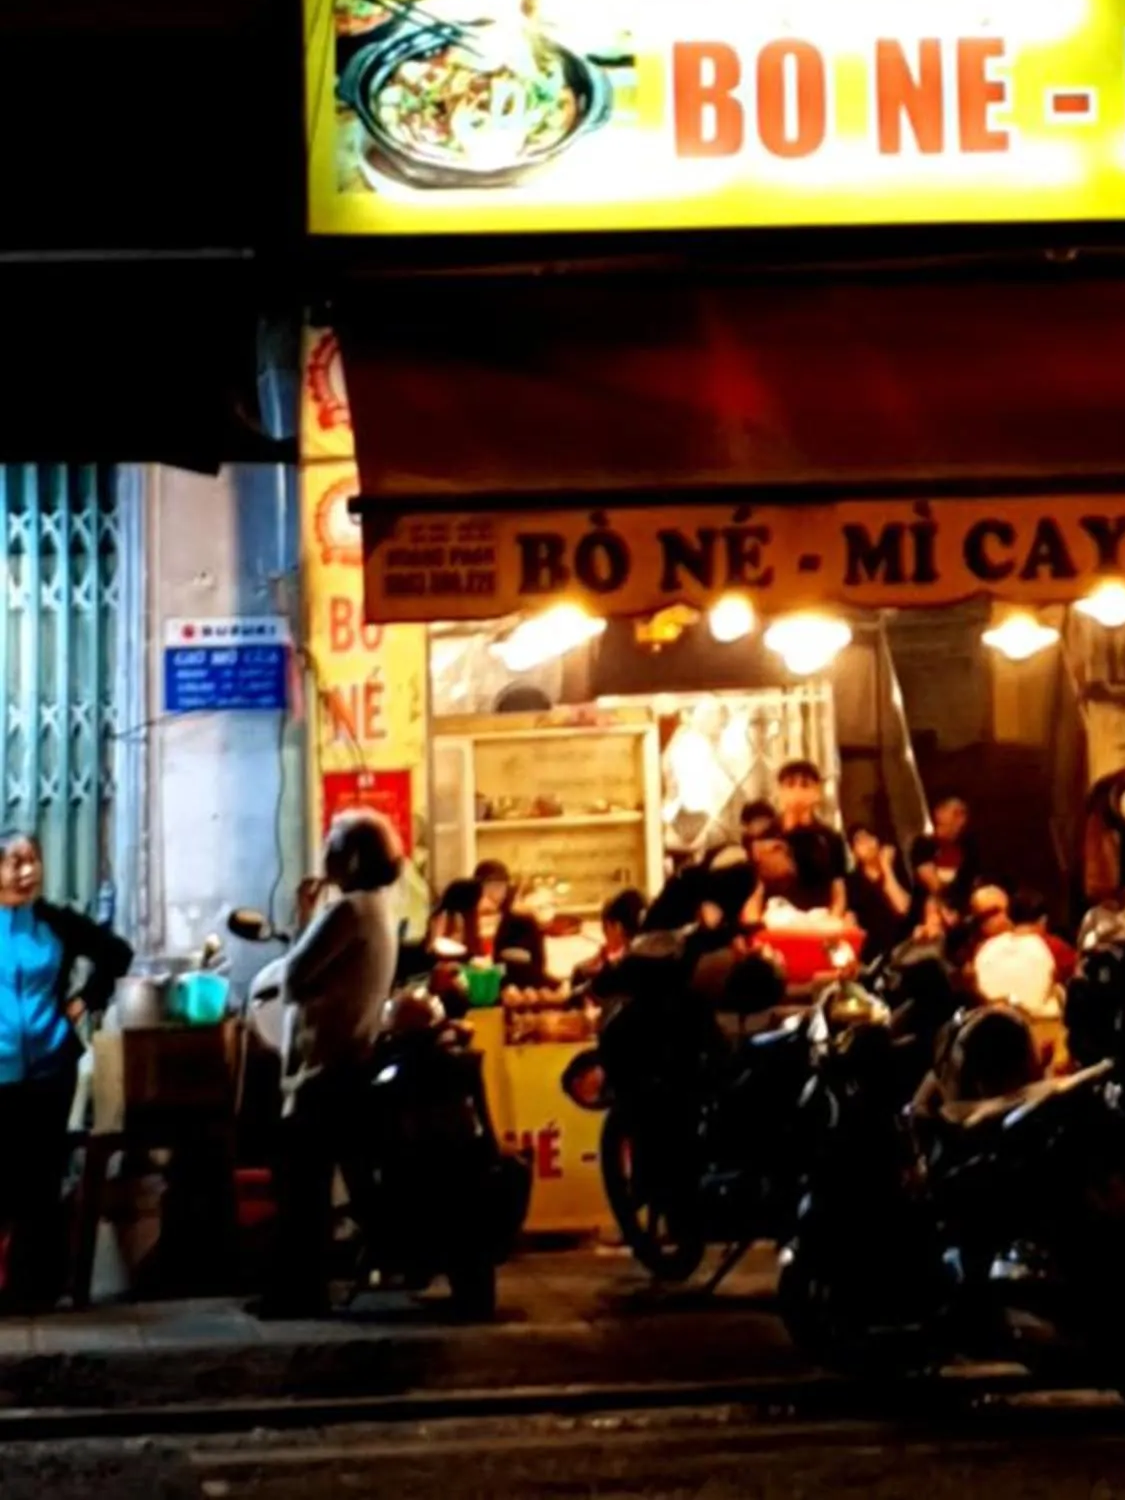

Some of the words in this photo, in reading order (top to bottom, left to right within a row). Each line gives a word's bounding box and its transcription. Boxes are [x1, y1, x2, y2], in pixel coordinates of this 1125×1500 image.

[515, 510, 631, 596] BÒ
[656, 503, 775, 593] NÉ
[842, 500, 940, 586] MÌ
